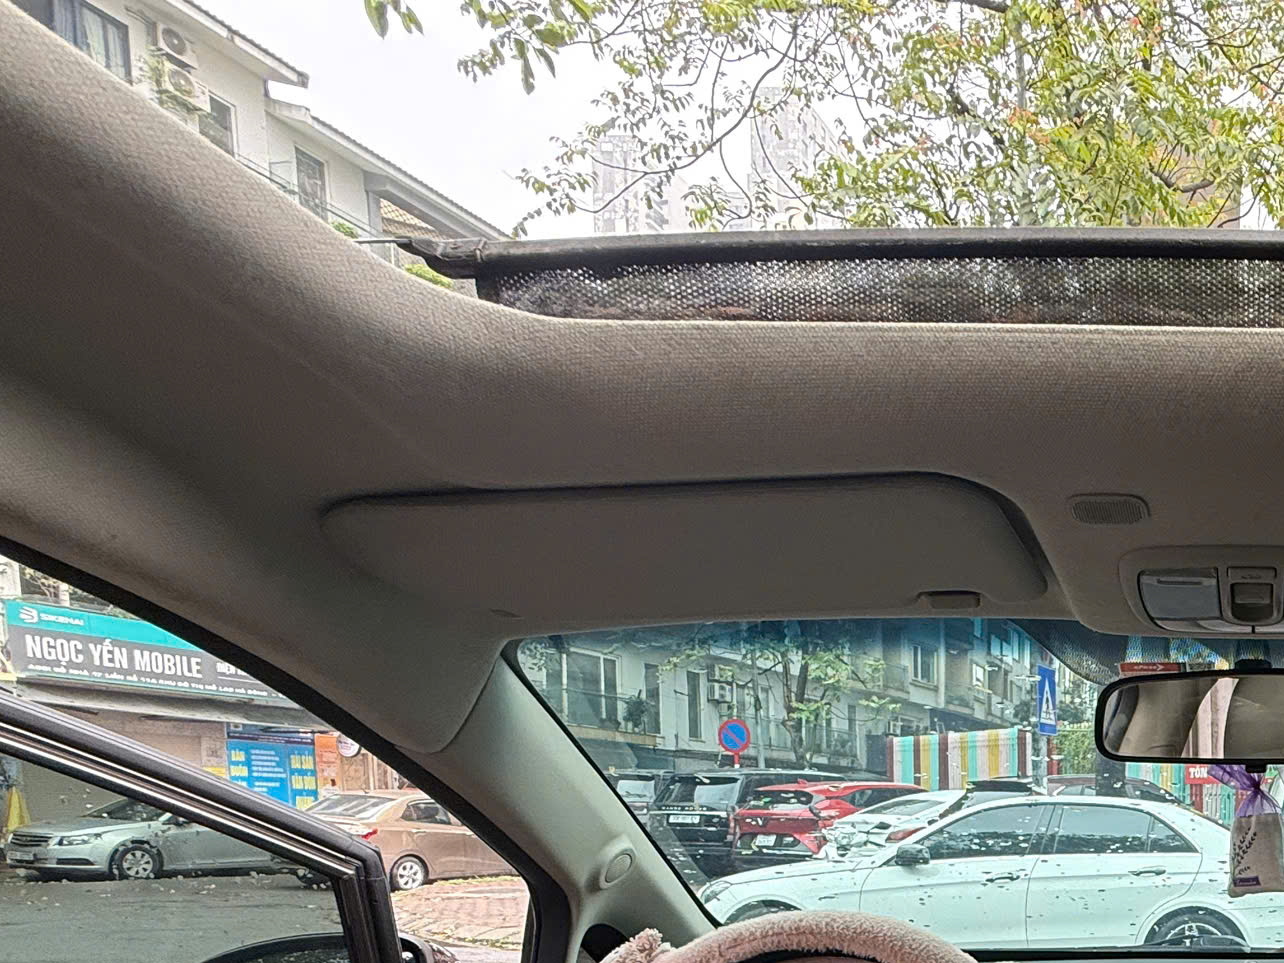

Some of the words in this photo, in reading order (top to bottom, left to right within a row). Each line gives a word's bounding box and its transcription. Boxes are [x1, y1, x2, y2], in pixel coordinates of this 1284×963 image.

[24, 634, 84, 666] NGỌC
[88, 638, 129, 670] YẾN
[134, 648, 203, 679] MOBILE
